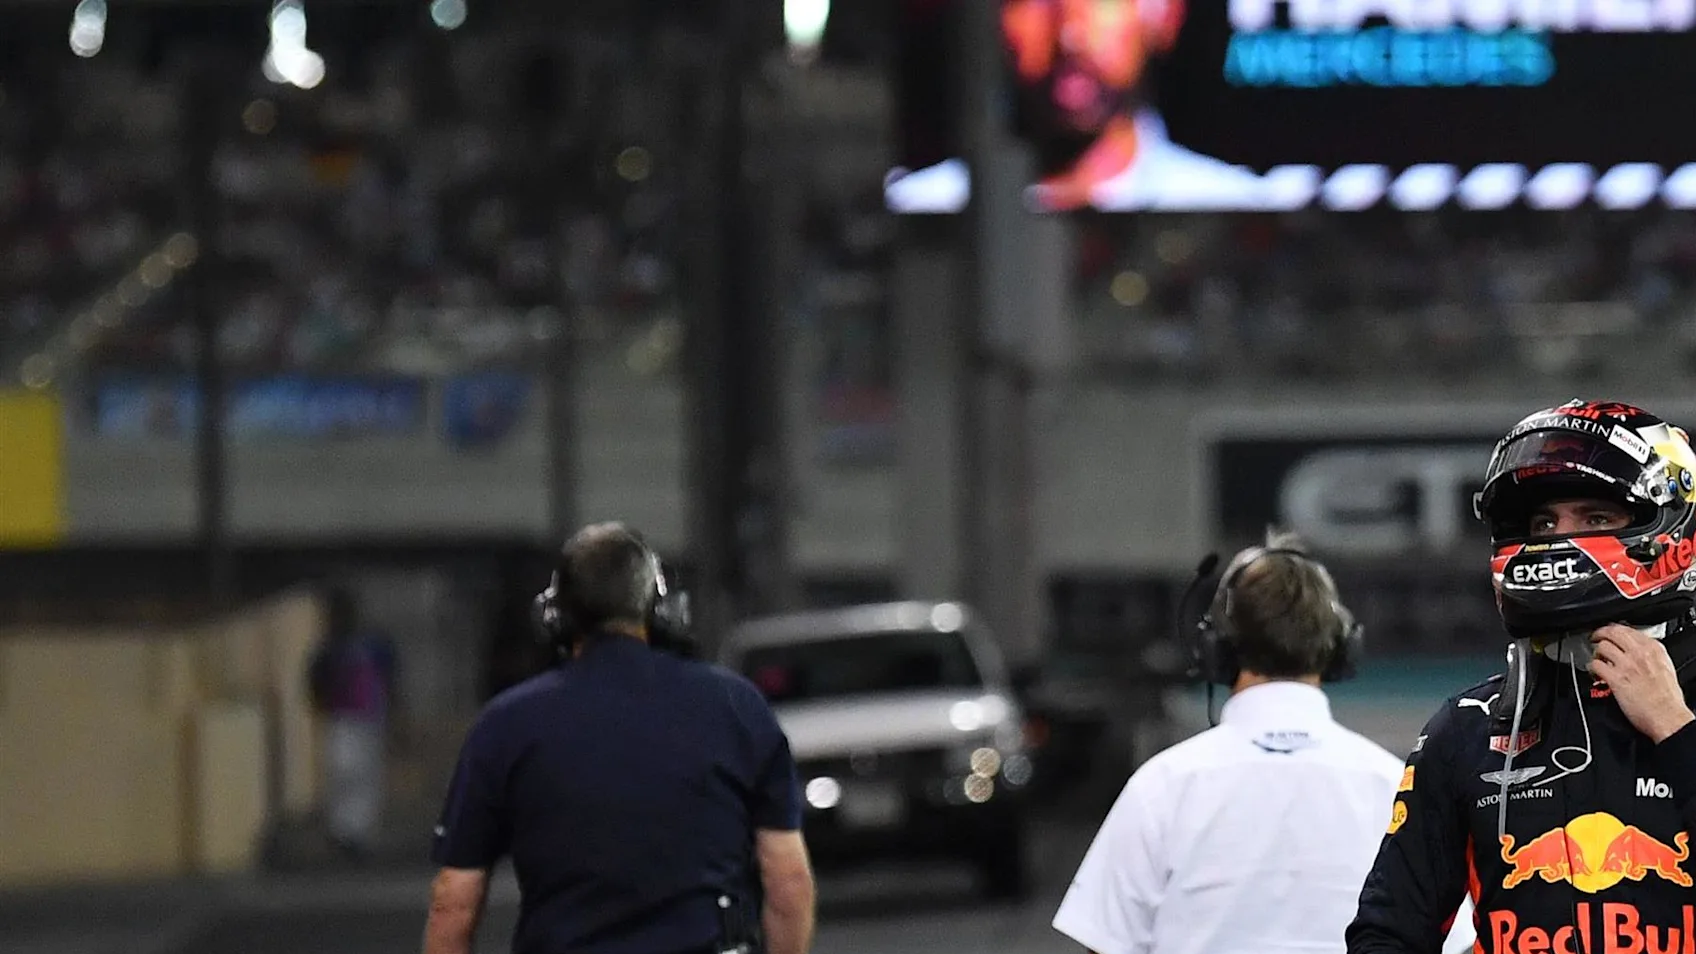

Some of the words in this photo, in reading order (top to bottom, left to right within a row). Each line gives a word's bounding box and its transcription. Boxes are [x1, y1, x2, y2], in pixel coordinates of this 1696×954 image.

[1500, 420, 1538, 446] STON
[1544, 416, 1611, 438] MARTIN
[1613, 430, 1639, 450] Mobil
[1476, 793, 1503, 809] ASTO
[1510, 788, 1554, 801] MARTIN
